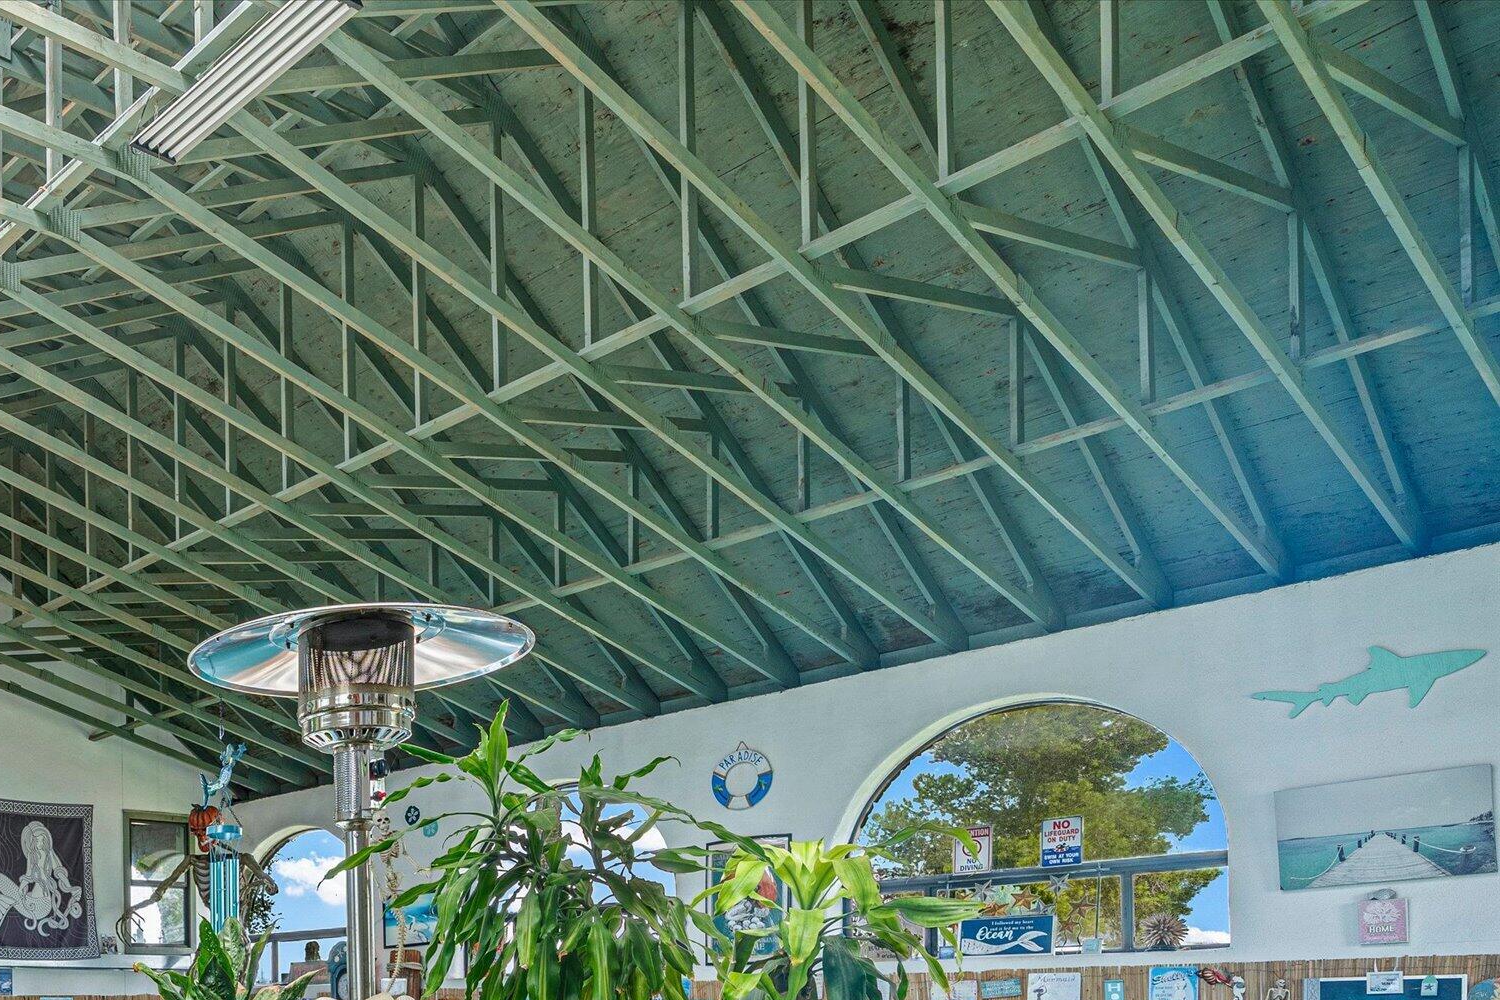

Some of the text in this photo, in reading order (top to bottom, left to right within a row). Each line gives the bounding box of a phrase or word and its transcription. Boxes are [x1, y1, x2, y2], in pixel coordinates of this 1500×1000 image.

[719, 751, 763, 770] PARADISE
[1053, 820, 1070, 830] NO
[1044, 828, 1079, 837] LIFEGUARD
[976, 925, 1013, 941] Ocean
[1369, 924, 1396, 934] HOME
